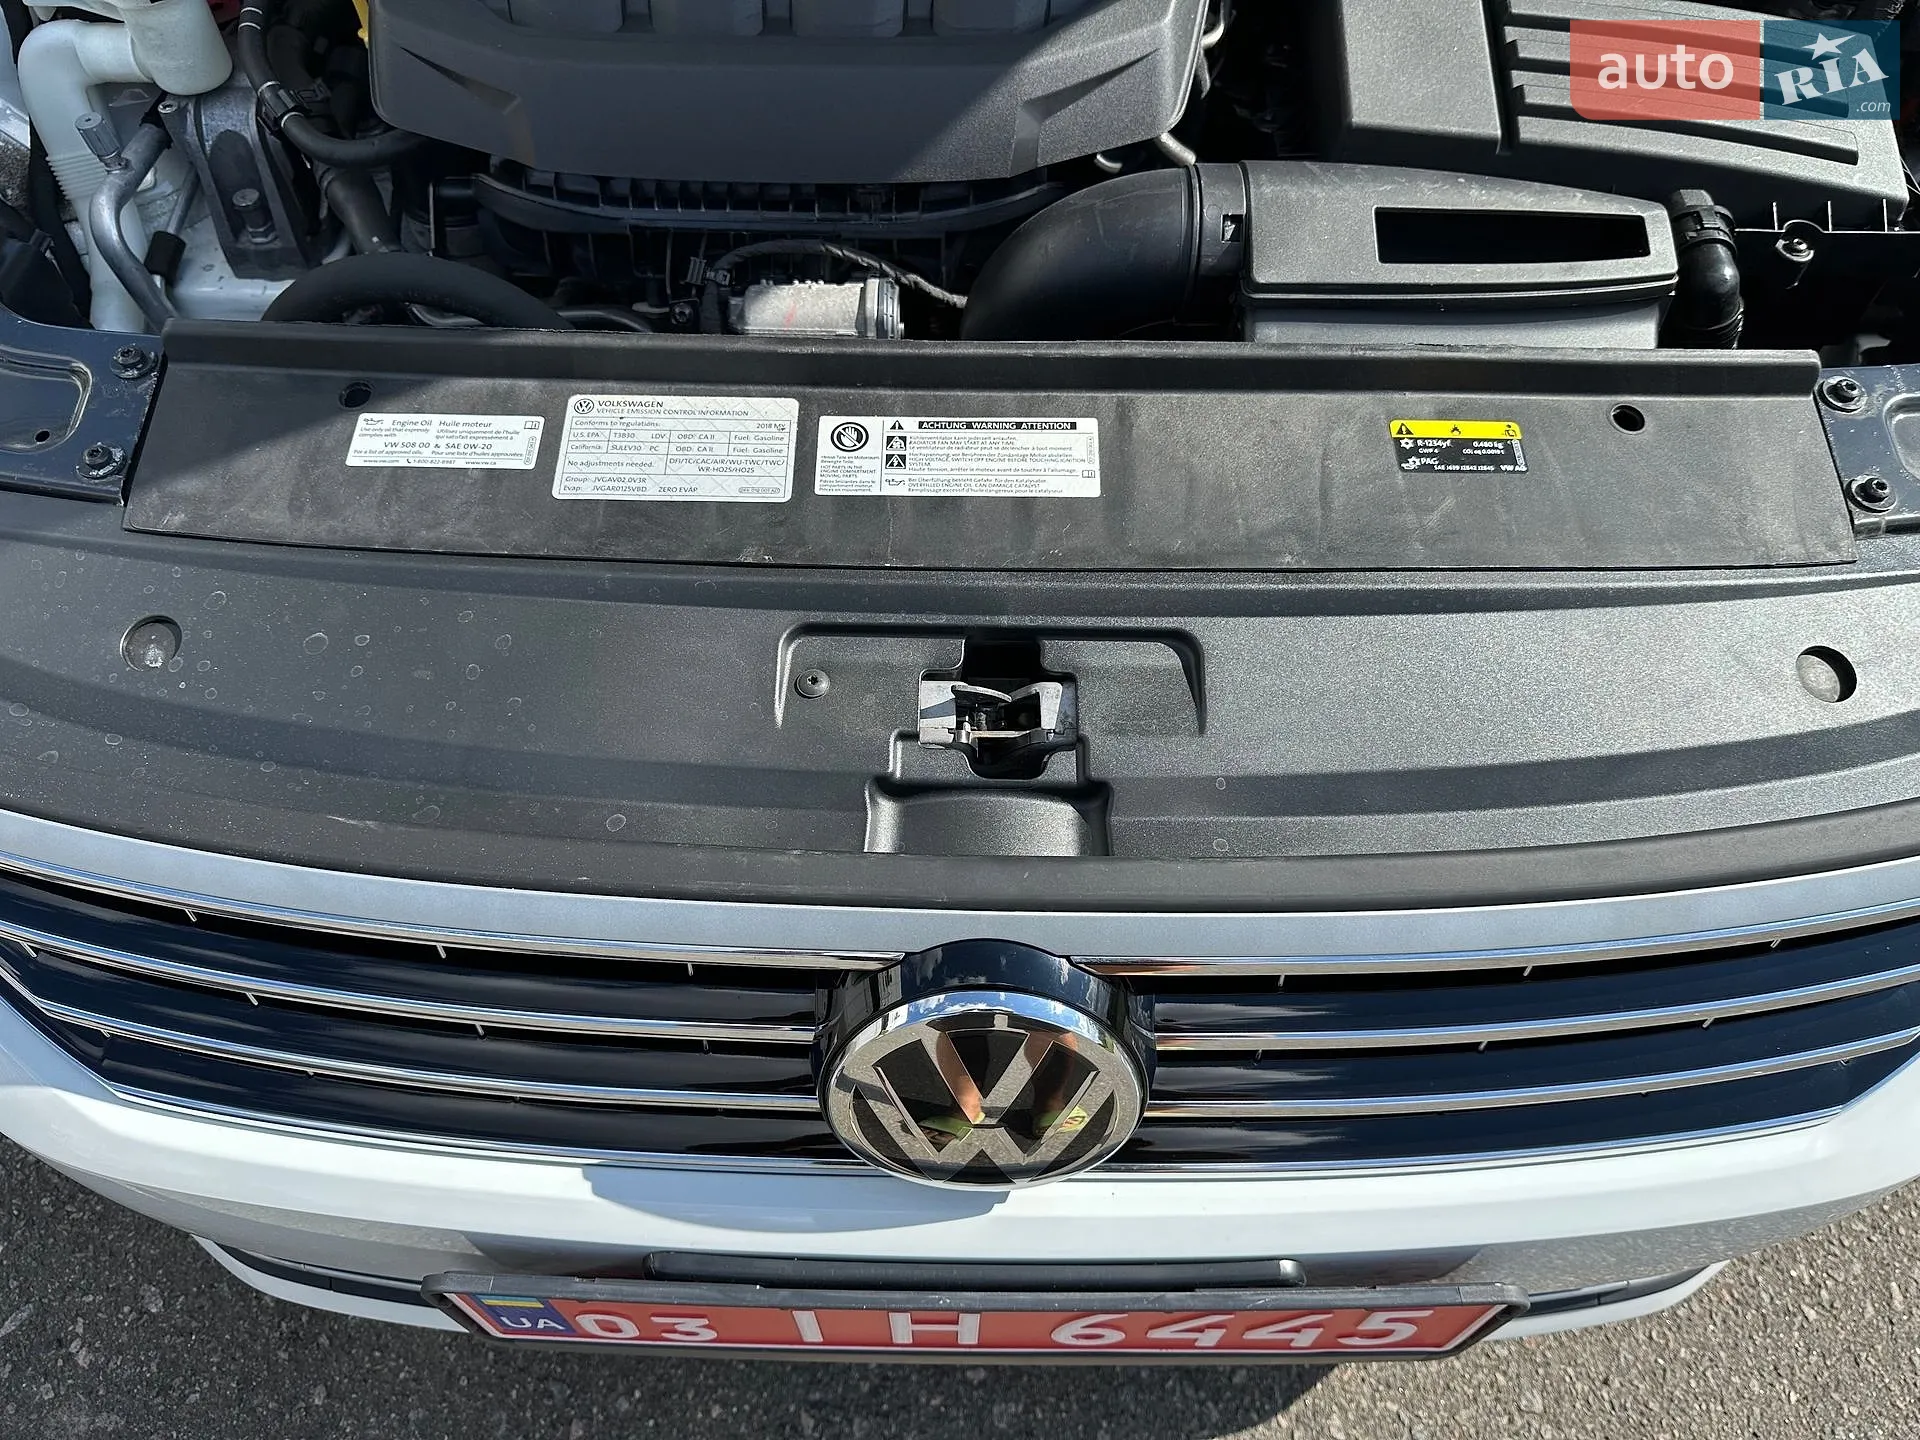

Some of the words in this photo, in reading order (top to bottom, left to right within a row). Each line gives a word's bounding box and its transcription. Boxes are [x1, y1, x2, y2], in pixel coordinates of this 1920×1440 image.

[1417, 440, 1452, 449] R-1234yf
[502, 1316, 566, 1330] UA
[576, 1313, 718, 1342] 03
[1050, 1310, 1445, 1347] 6445
